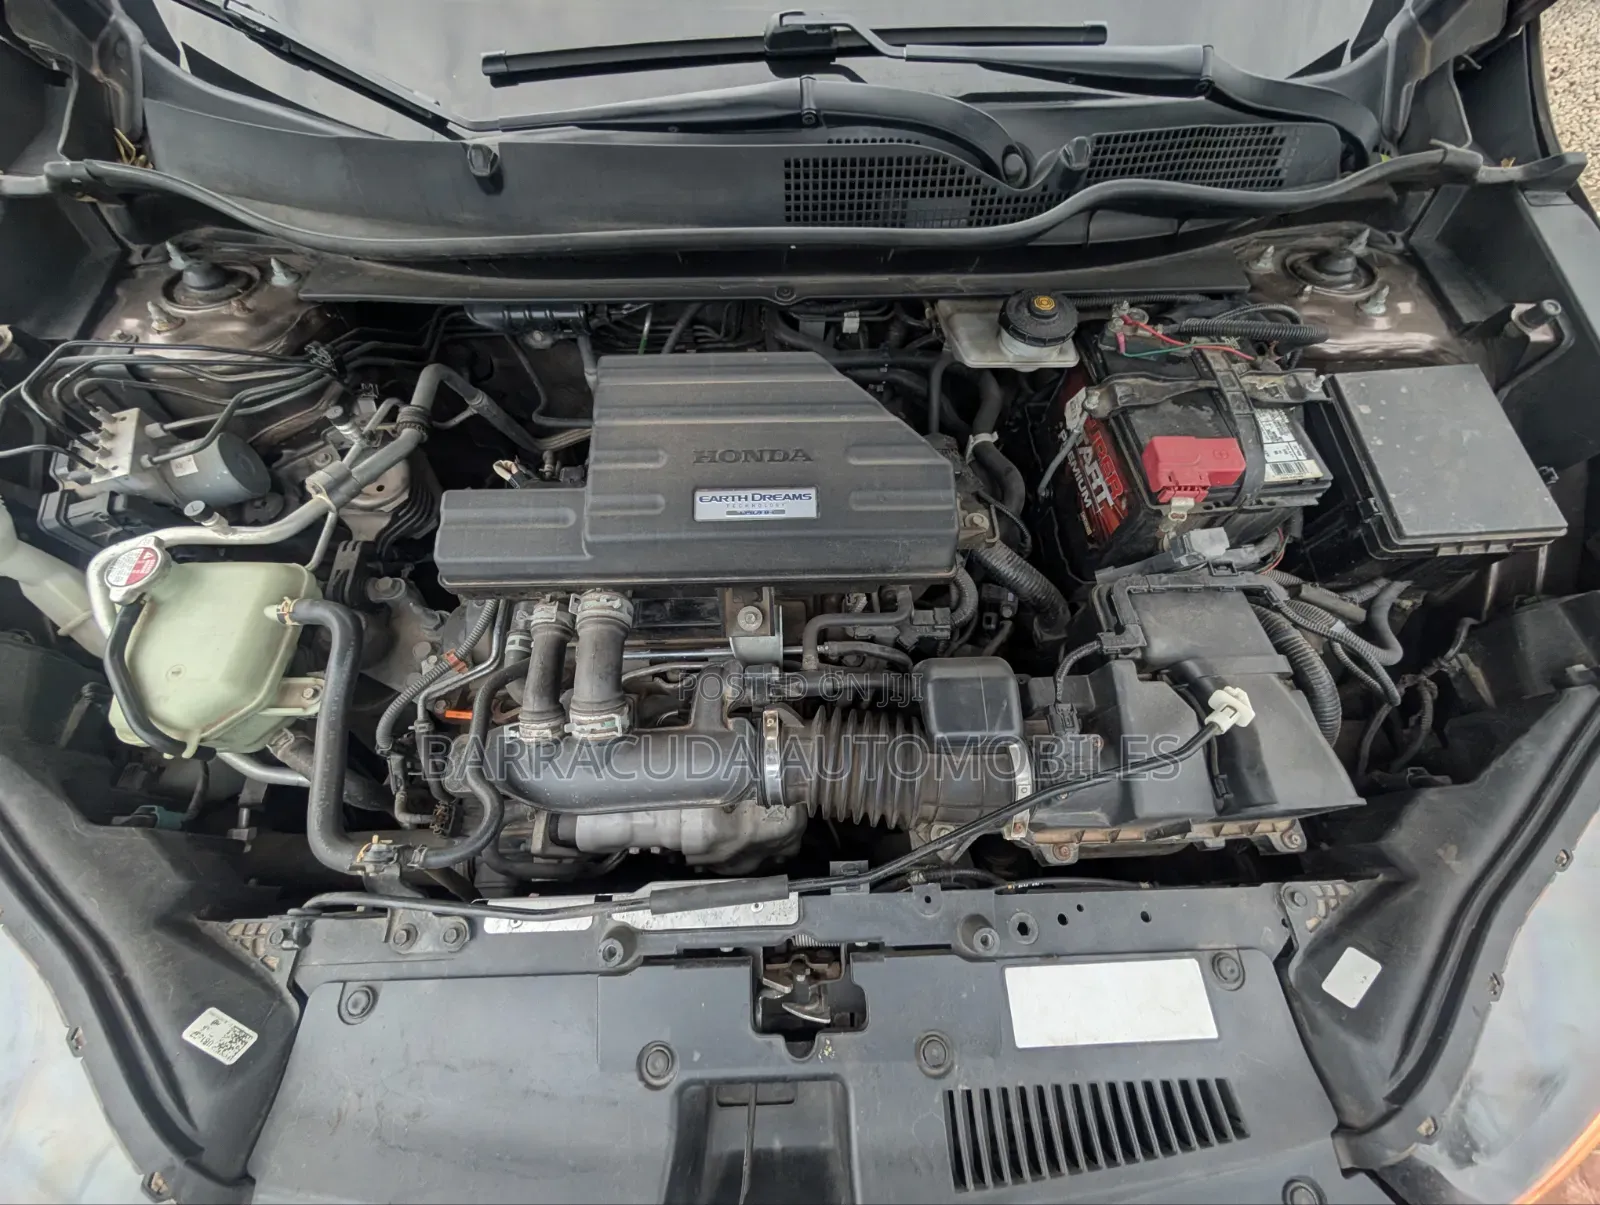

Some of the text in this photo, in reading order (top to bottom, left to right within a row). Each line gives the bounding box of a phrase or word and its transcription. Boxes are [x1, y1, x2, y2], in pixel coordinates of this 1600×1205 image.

[692, 449, 814, 464] HONDA
[1058, 429, 1093, 508] PEMIUM
[698, 492, 813, 503] EARTH DREAMS
